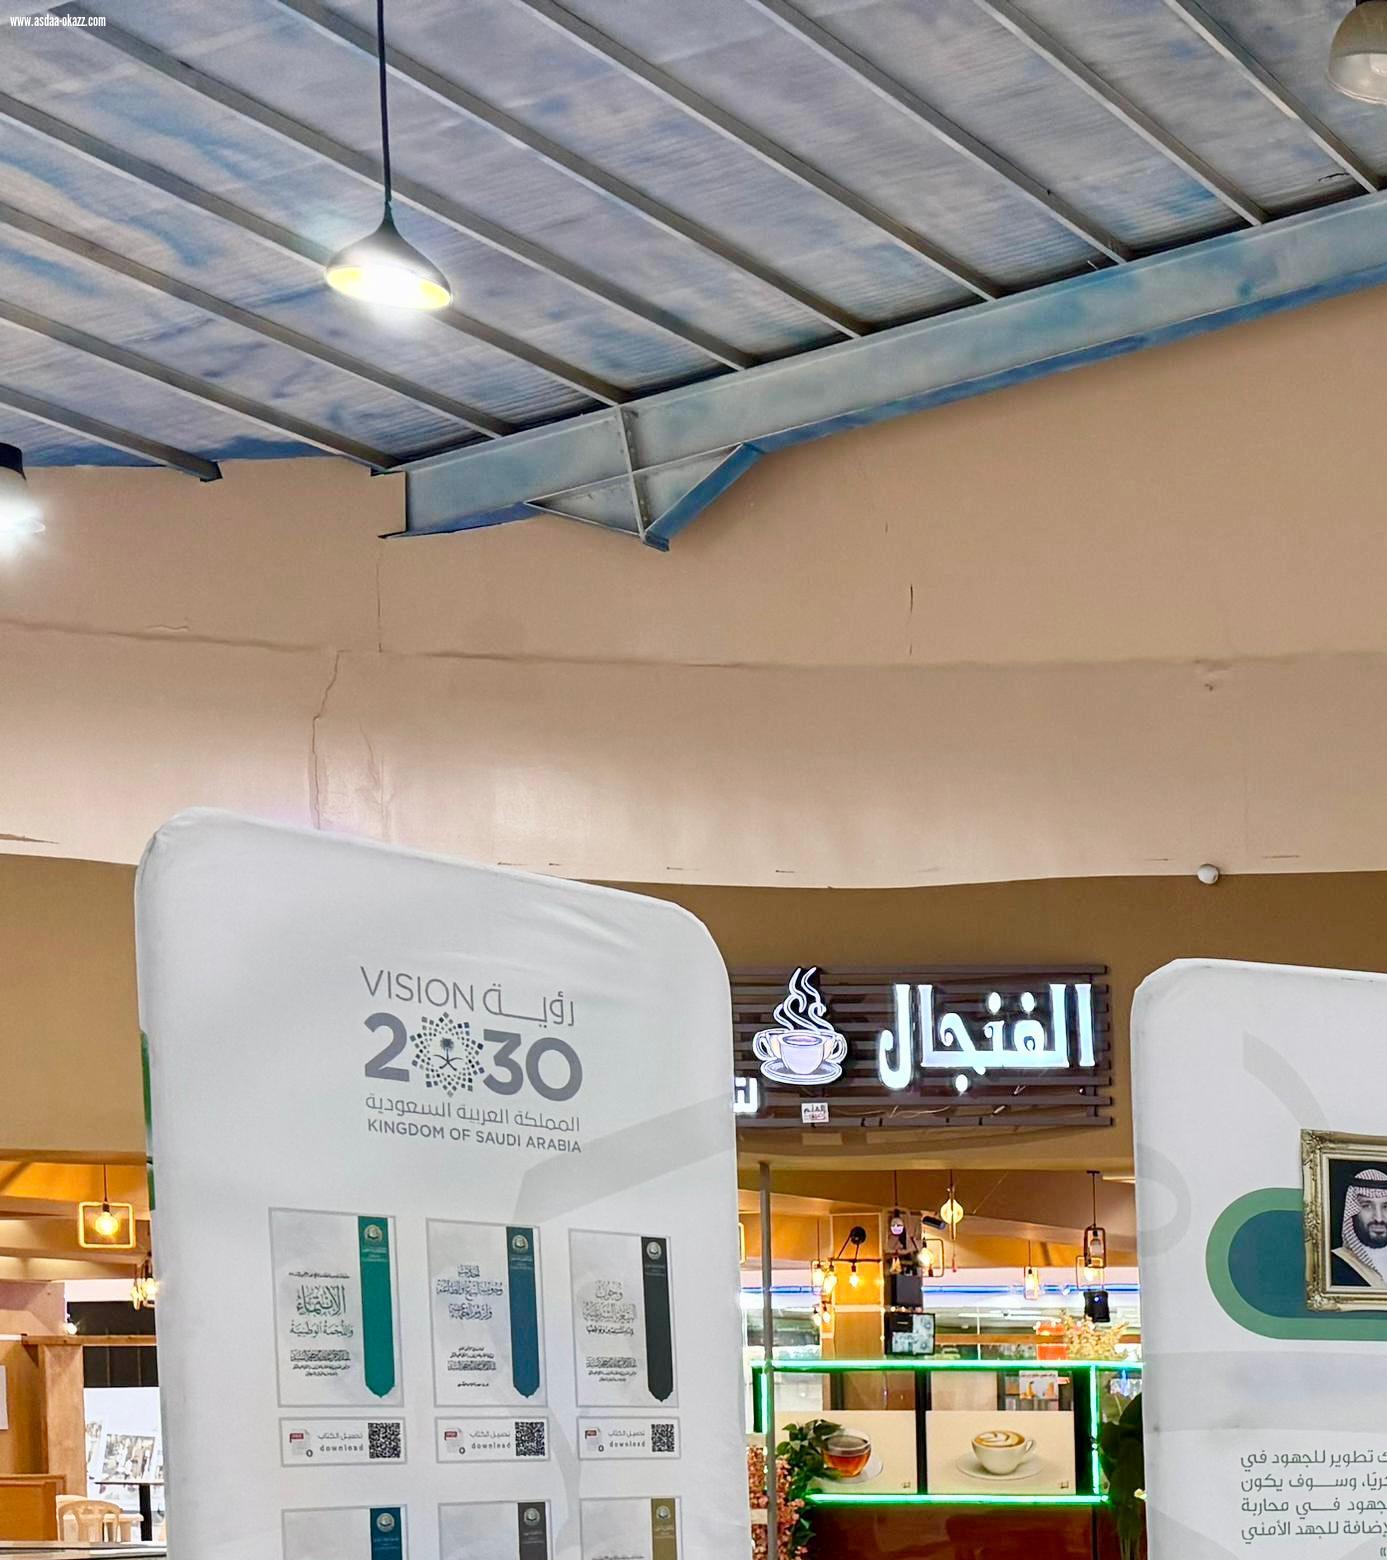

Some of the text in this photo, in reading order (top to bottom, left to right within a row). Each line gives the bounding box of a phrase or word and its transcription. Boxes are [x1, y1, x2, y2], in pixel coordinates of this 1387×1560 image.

[360, 966, 474, 1011] VISION
[878, 983, 1096, 1094] الفنجال
[366, 1093, 579, 1132] المملكة العربية السعودية
[368, 1119, 581, 1153] KINGDOM OF SAUDI ARABIA
